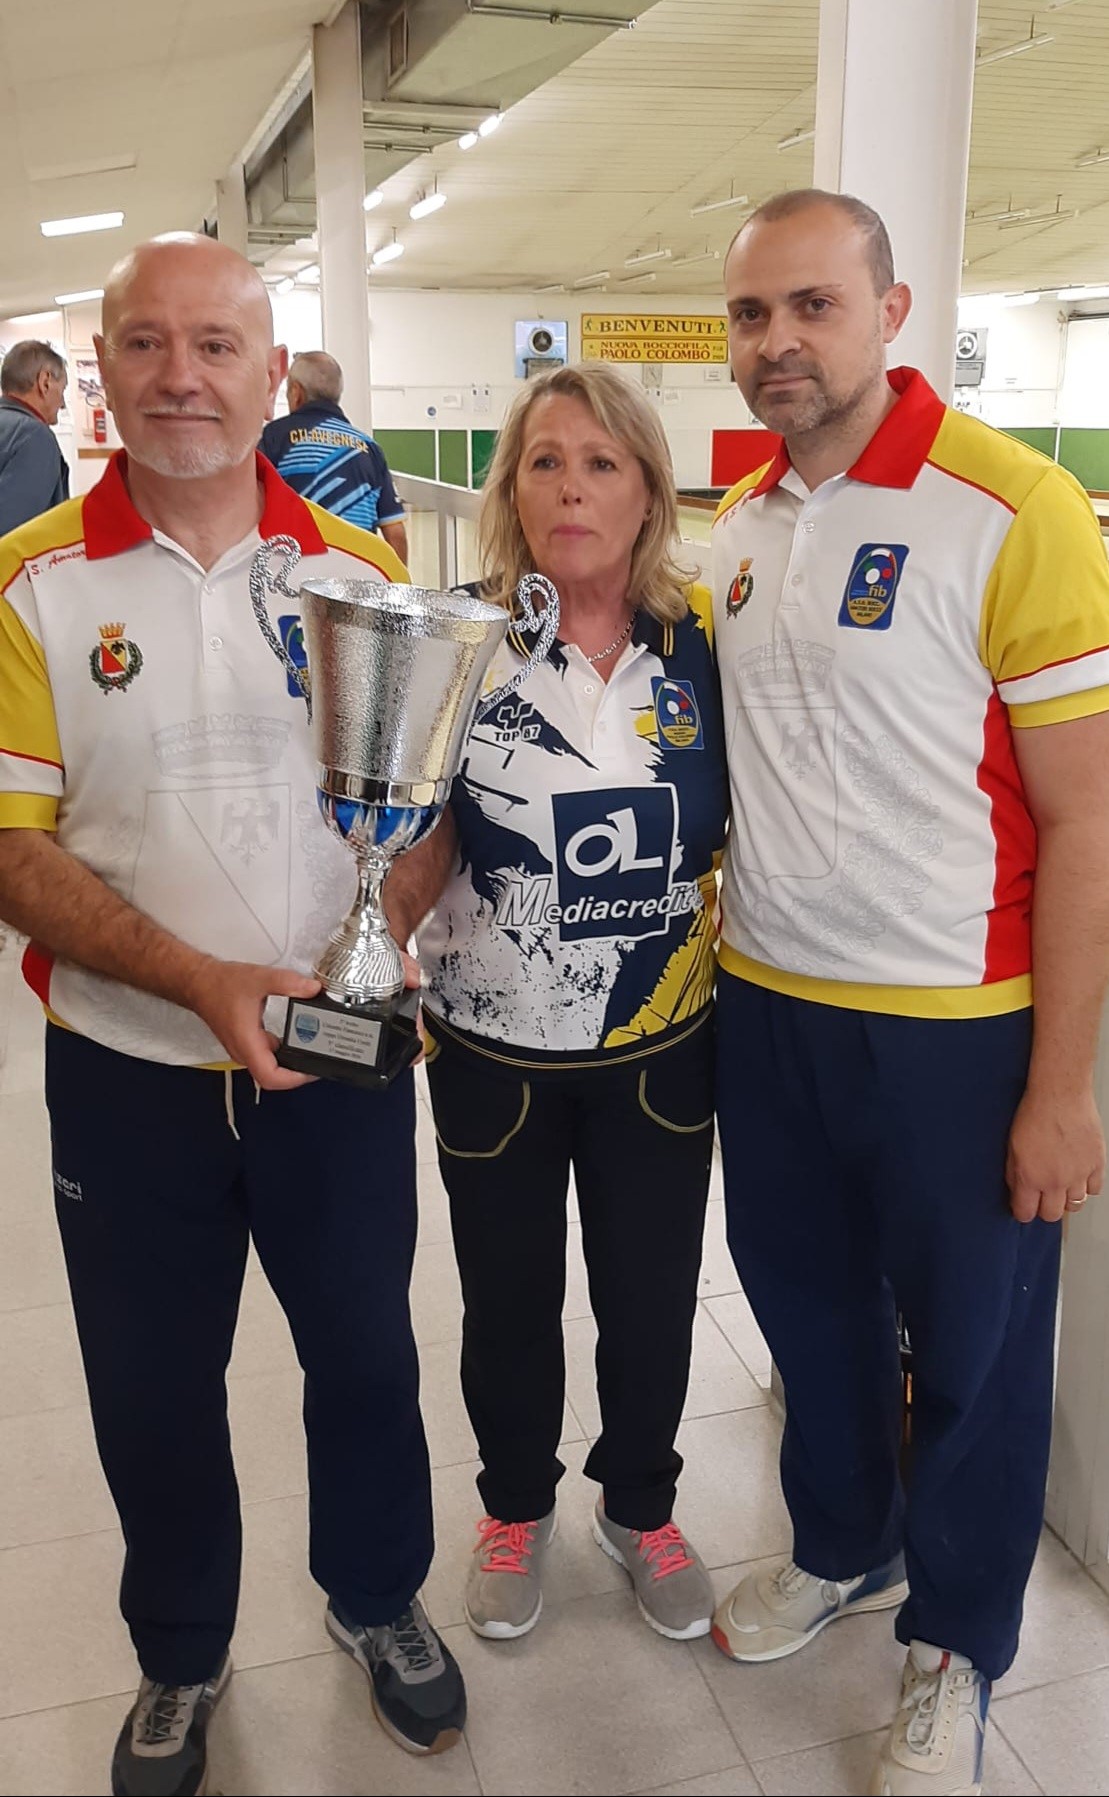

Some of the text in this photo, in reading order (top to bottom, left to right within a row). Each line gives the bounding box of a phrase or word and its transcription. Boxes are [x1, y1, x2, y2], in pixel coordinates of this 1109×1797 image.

[600, 319, 712, 334] BENVENUTI
[601, 341, 638, 349] NUOVA
[643, 341, 710, 350] BOCCIOFILA
[600, 350, 641, 360] PAOLO
[646, 350, 710, 360] COLOMBO
[869, 585, 887, 597] fib
[675, 714, 693, 725] fib
[494, 731, 519, 742] TOP
